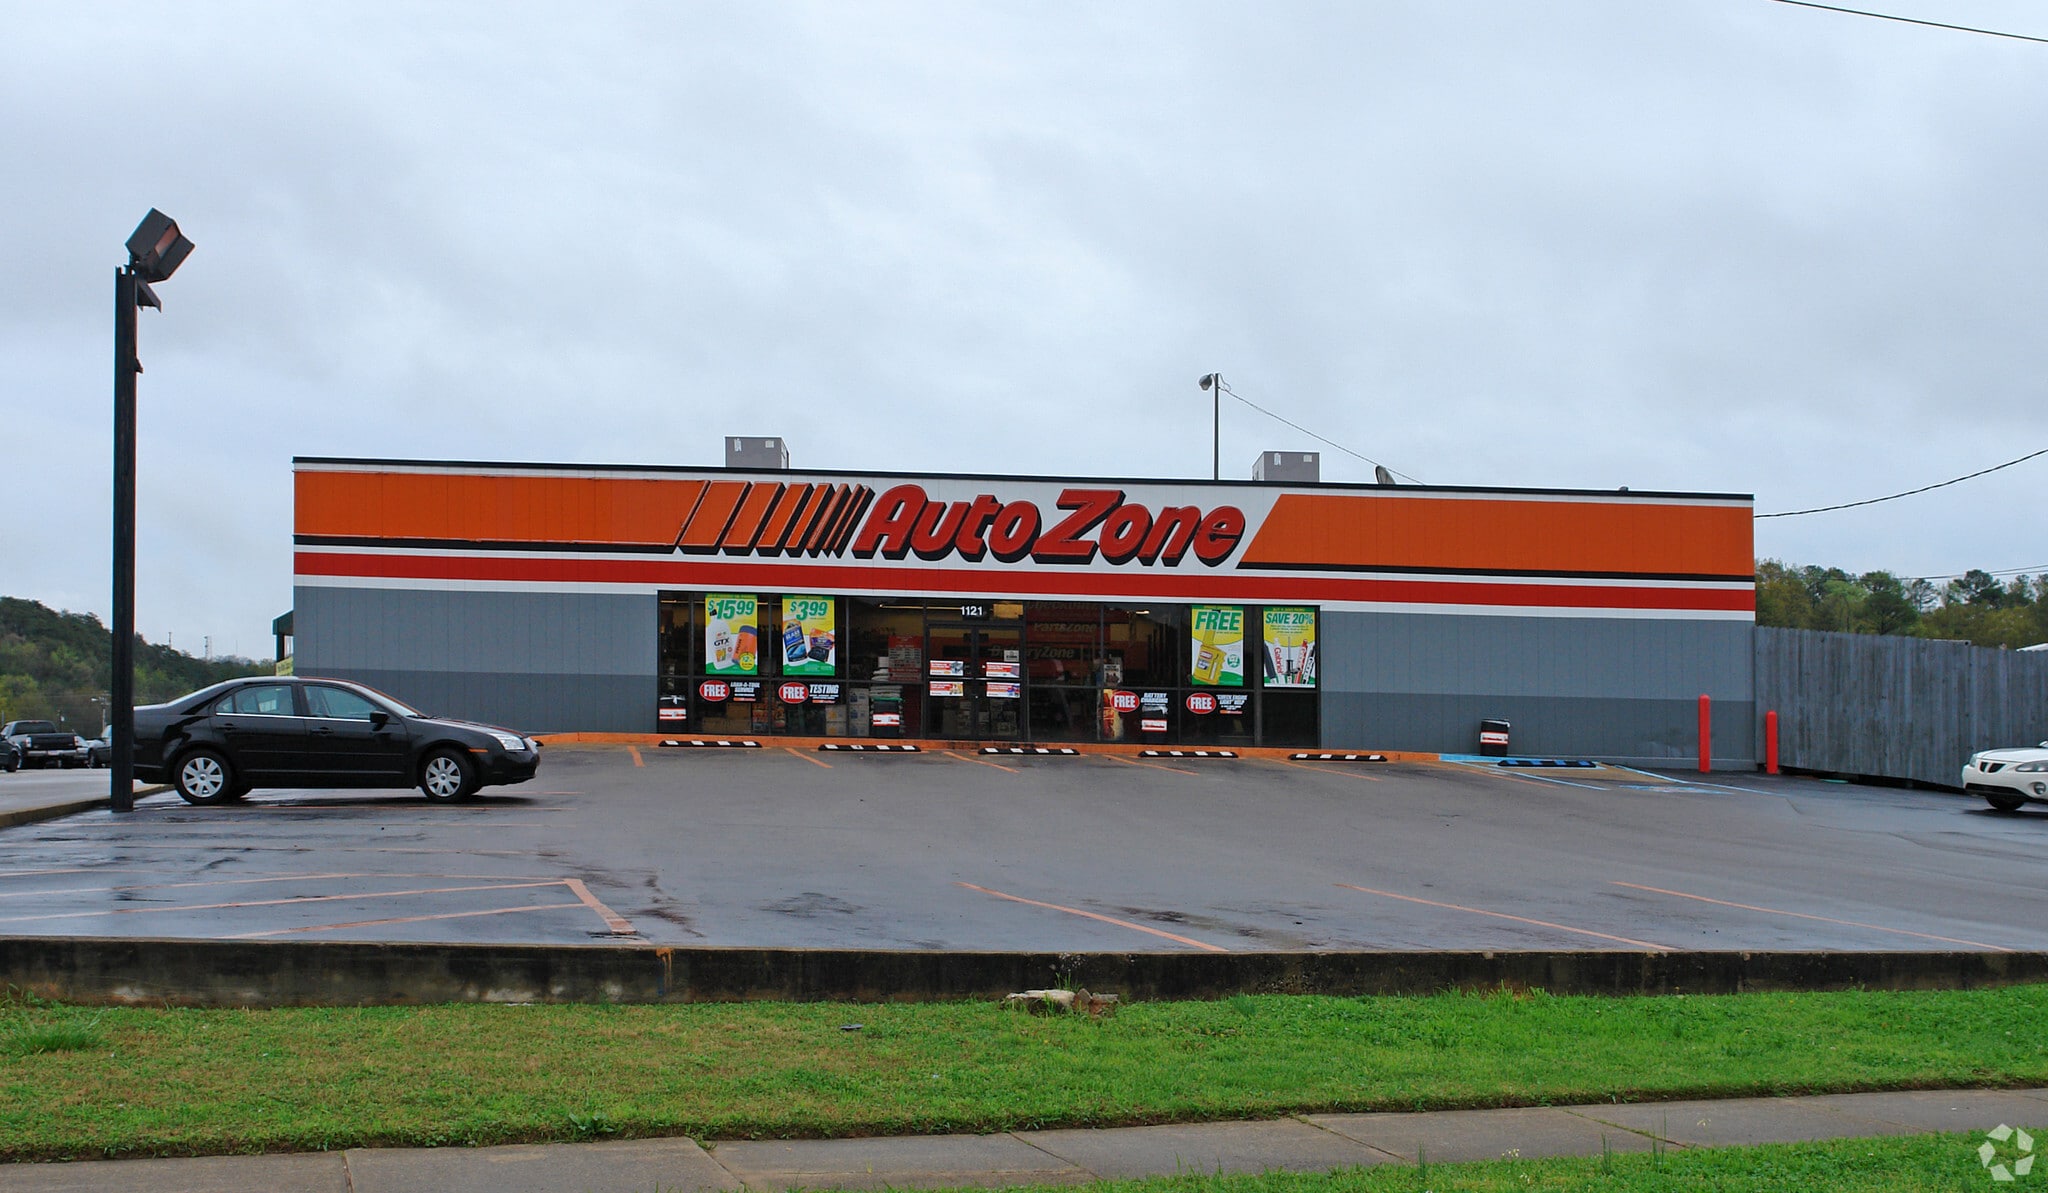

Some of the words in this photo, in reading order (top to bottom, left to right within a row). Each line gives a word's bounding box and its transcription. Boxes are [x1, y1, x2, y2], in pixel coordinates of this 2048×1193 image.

[961, 605, 982, 616] 1121
[1195, 611, 1242, 631] FREE
[1265, 612, 1290, 625] SAVE
[1291, 613, 1314, 625] 20%
[714, 637, 729, 646] GTX
[704, 684, 726, 697] FREE
[783, 686, 805, 699] FREE
[809, 684, 839, 694] TESTING
[1113, 695, 1136, 708] FREE
[1190, 697, 1212, 710] FREE
